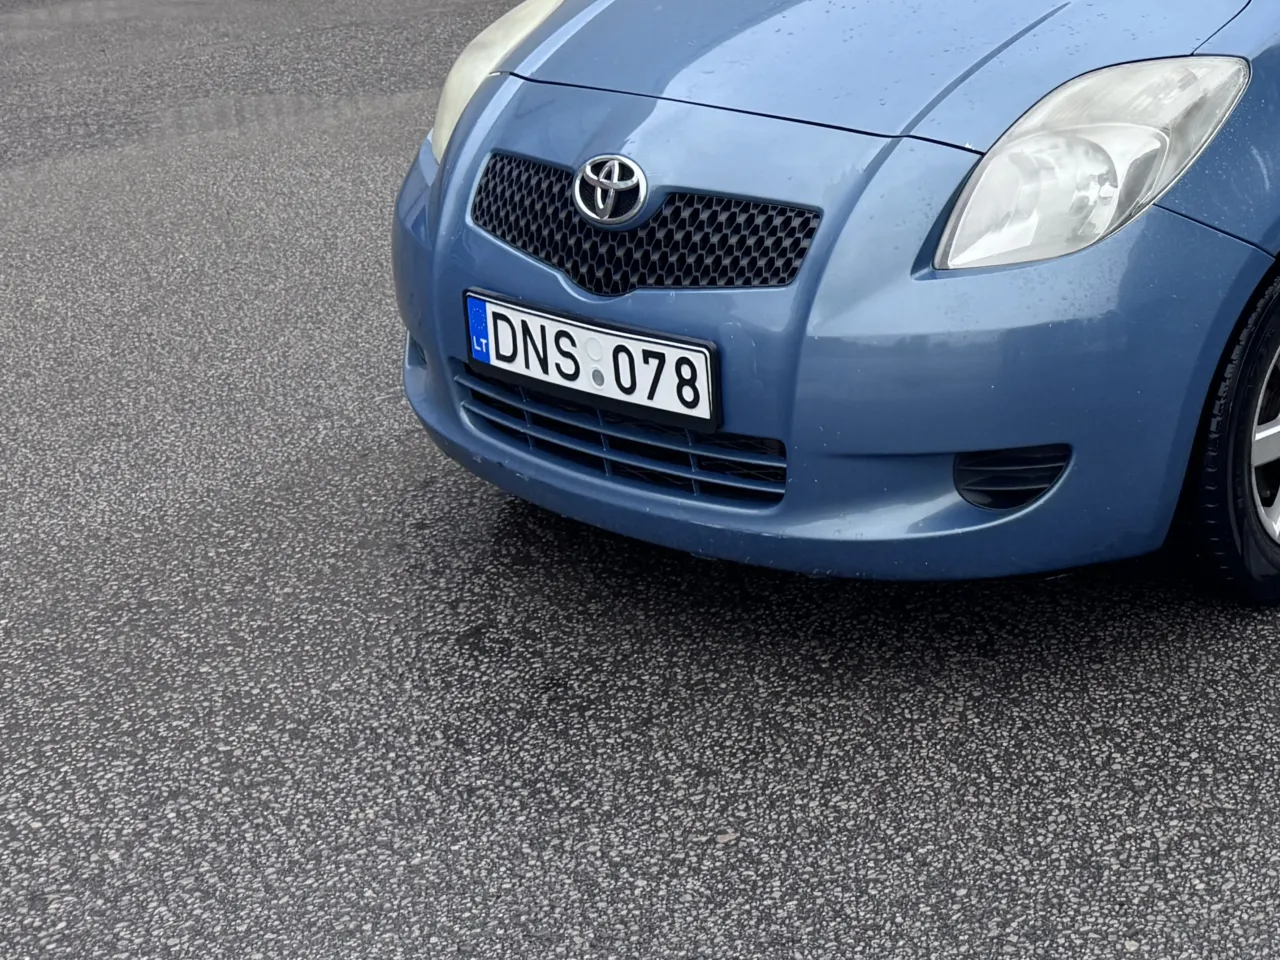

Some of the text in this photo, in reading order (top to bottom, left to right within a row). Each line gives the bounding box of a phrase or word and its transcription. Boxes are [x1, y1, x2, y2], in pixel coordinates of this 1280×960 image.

[471, 337, 488, 354] LT
[491, 310, 701, 410] DNS 078
